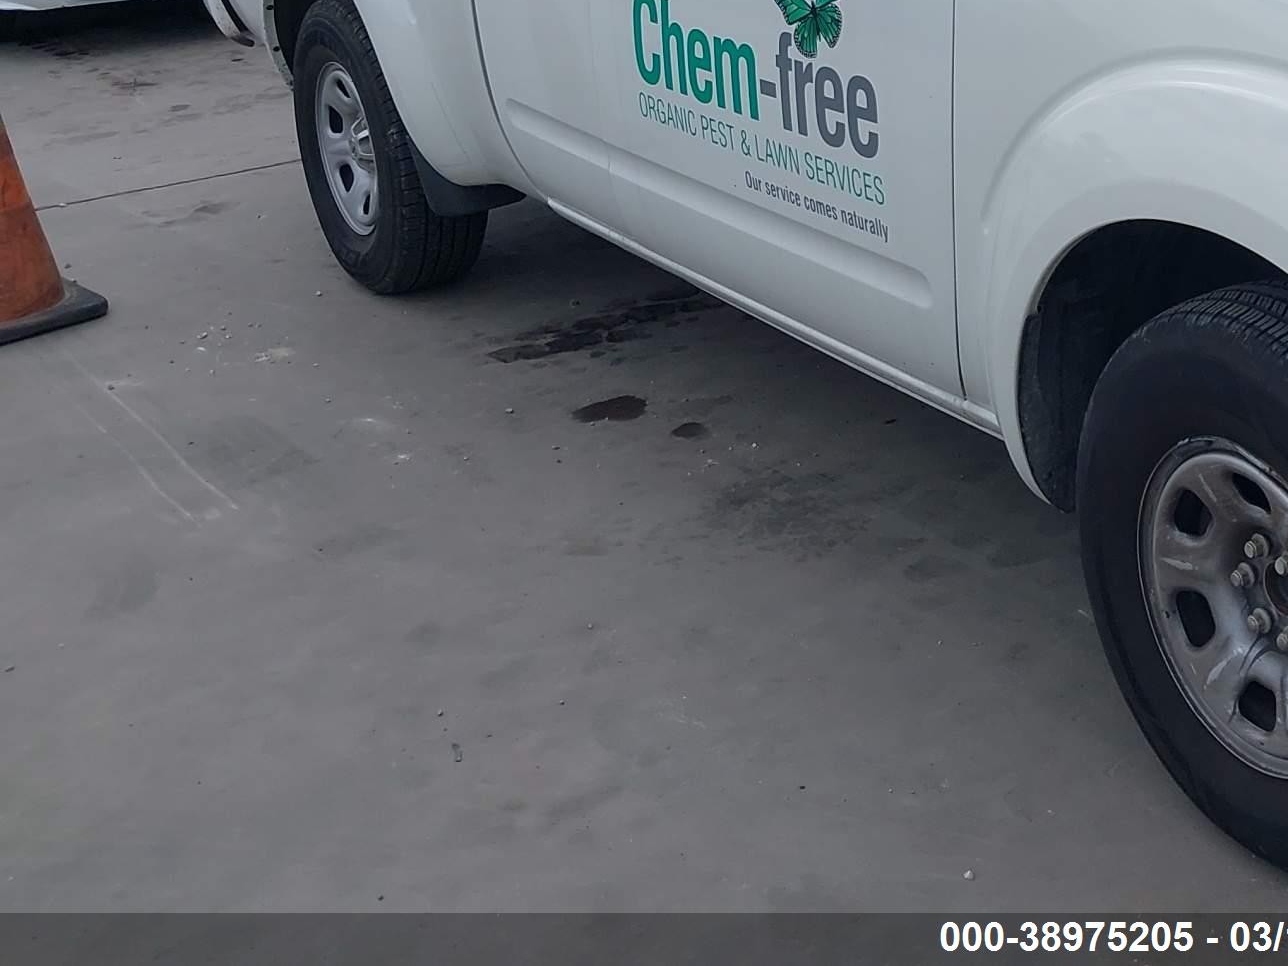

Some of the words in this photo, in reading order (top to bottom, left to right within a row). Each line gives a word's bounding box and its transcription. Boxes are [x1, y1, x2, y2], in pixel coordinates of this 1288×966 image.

[638, 91, 698, 136] ORGANIC
[700, 114, 735, 151] PEST
[740, 129, 752, 157] &
[754, 135, 801, 177] LAWN
[804, 151, 886, 206] SERVICES
[744, 170, 763, 193] Our
[764, 180, 801, 207] service
[803, 194, 838, 222] comes
[840, 208, 889, 244] naturally
